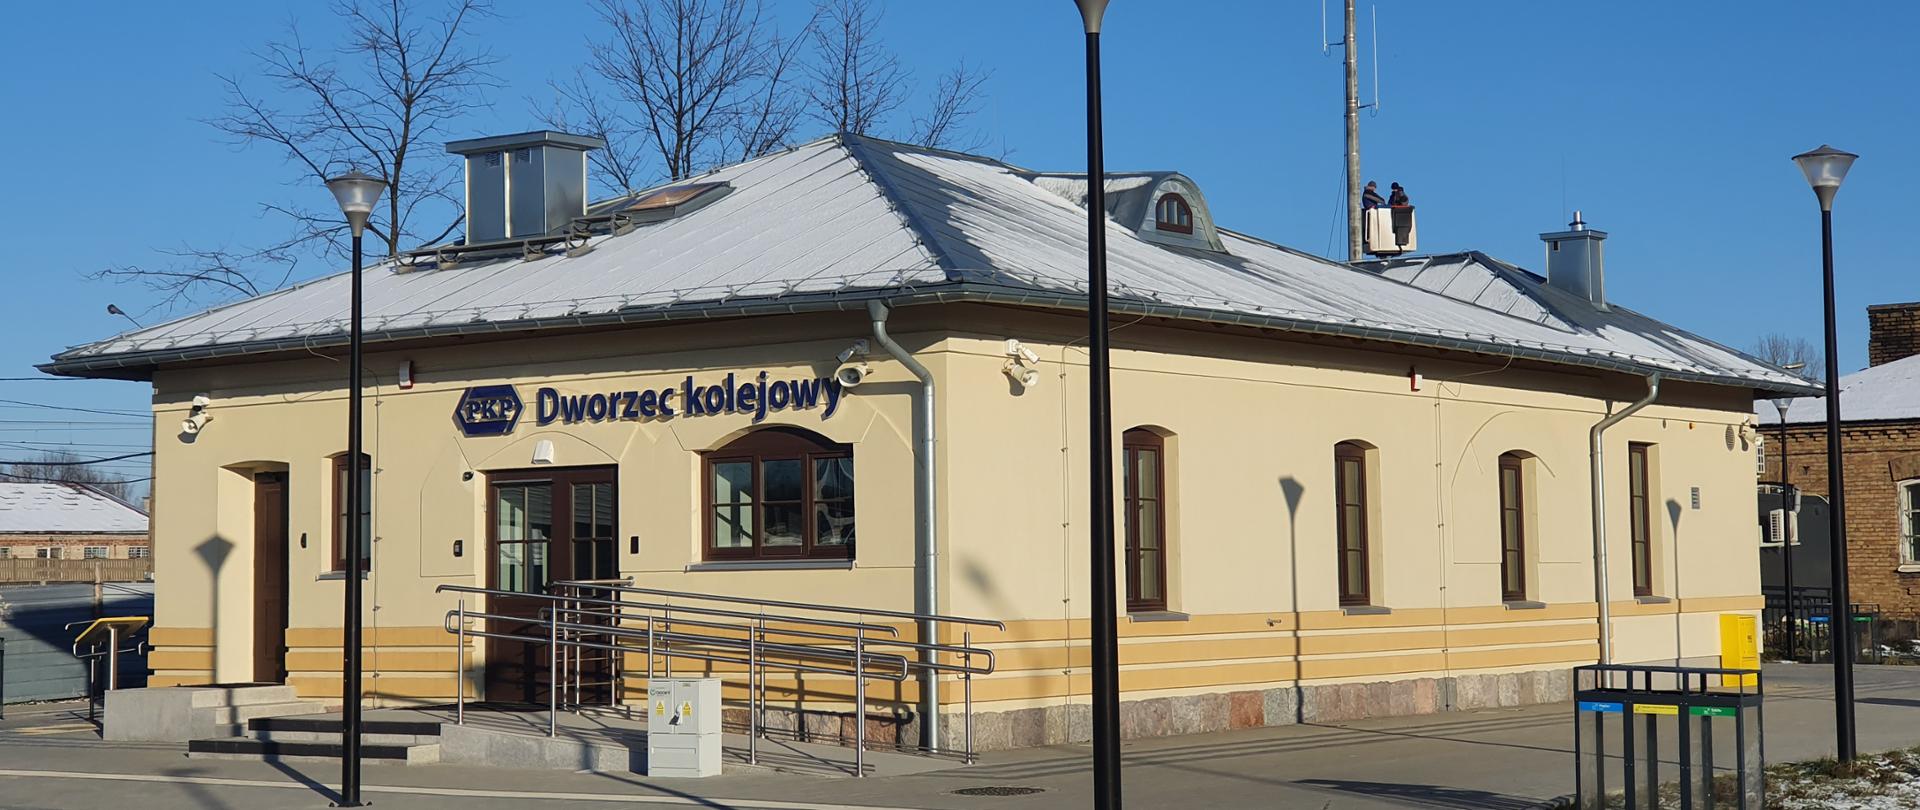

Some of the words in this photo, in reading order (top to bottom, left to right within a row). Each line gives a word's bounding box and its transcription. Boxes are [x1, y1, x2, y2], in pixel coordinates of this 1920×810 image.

[465, 396, 515, 422] PKP
[536, 386, 677, 427] Dworzec
[685, 369, 842, 424] kolejowy
